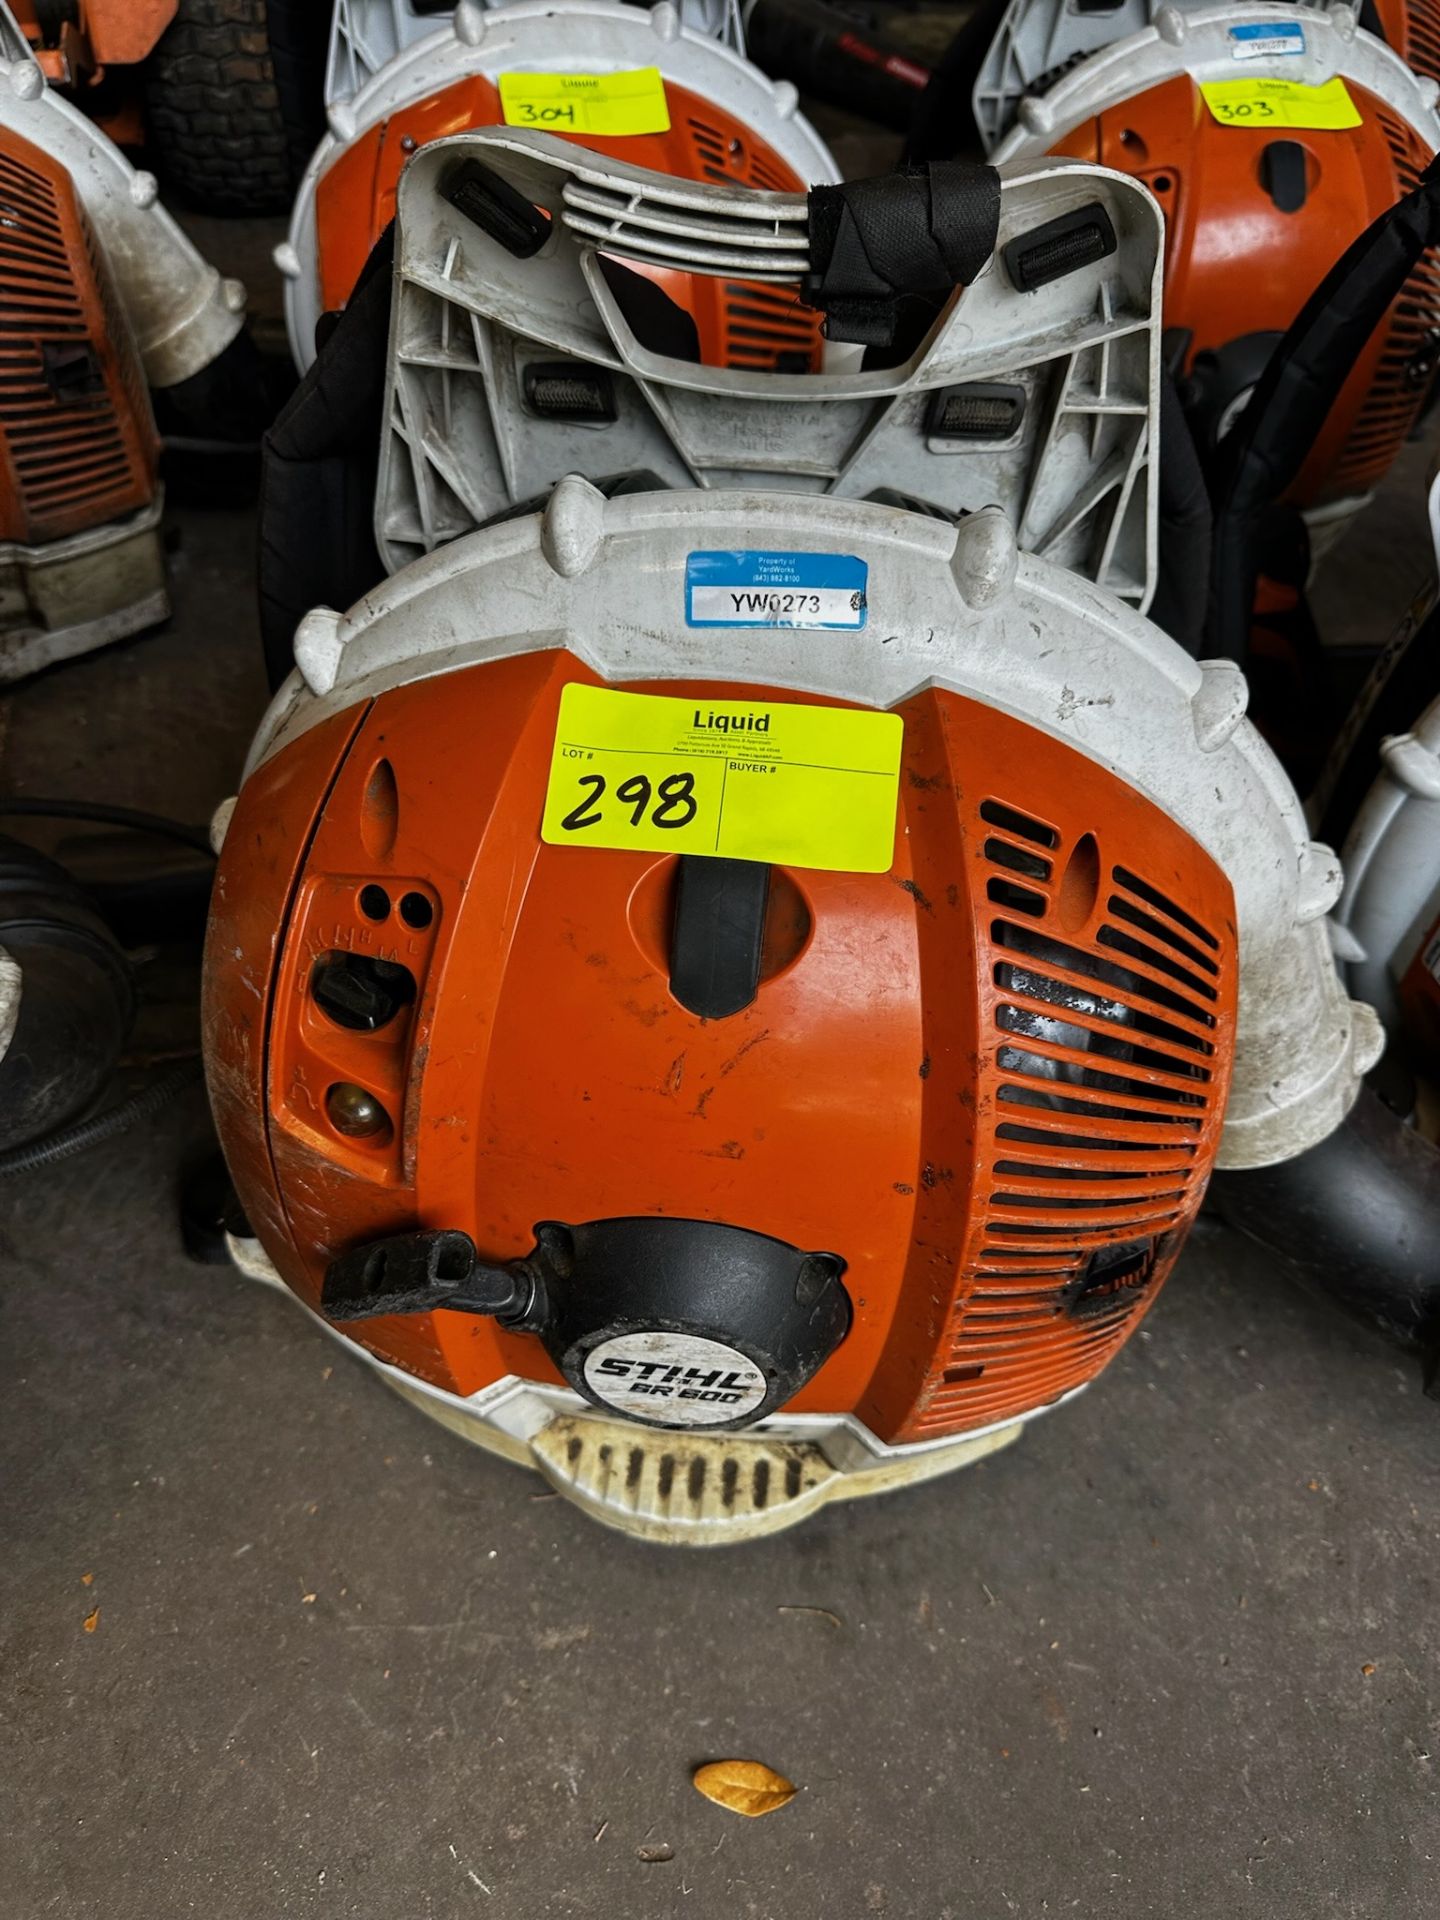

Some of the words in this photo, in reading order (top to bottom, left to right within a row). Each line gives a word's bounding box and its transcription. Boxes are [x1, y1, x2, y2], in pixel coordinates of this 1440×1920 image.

[518, 103, 575, 125] 304
[1216, 101, 1274, 119] 303
[758, 556, 788, 566] Property
[789, 557, 796, 565] of
[759, 565, 795, 574] YardWorks
[752, 574, 769, 583] (843)
[730, 592, 821, 614] YW0273
[693, 709, 770, 733] Liquid
[561, 748, 584, 760] LOT
[586, 750, 594, 761] #
[729, 761, 767, 774] BUYER
[769, 765, 777, 774] #
[561, 771, 698, 831] 298
[677, 1389, 744, 1404] 600
